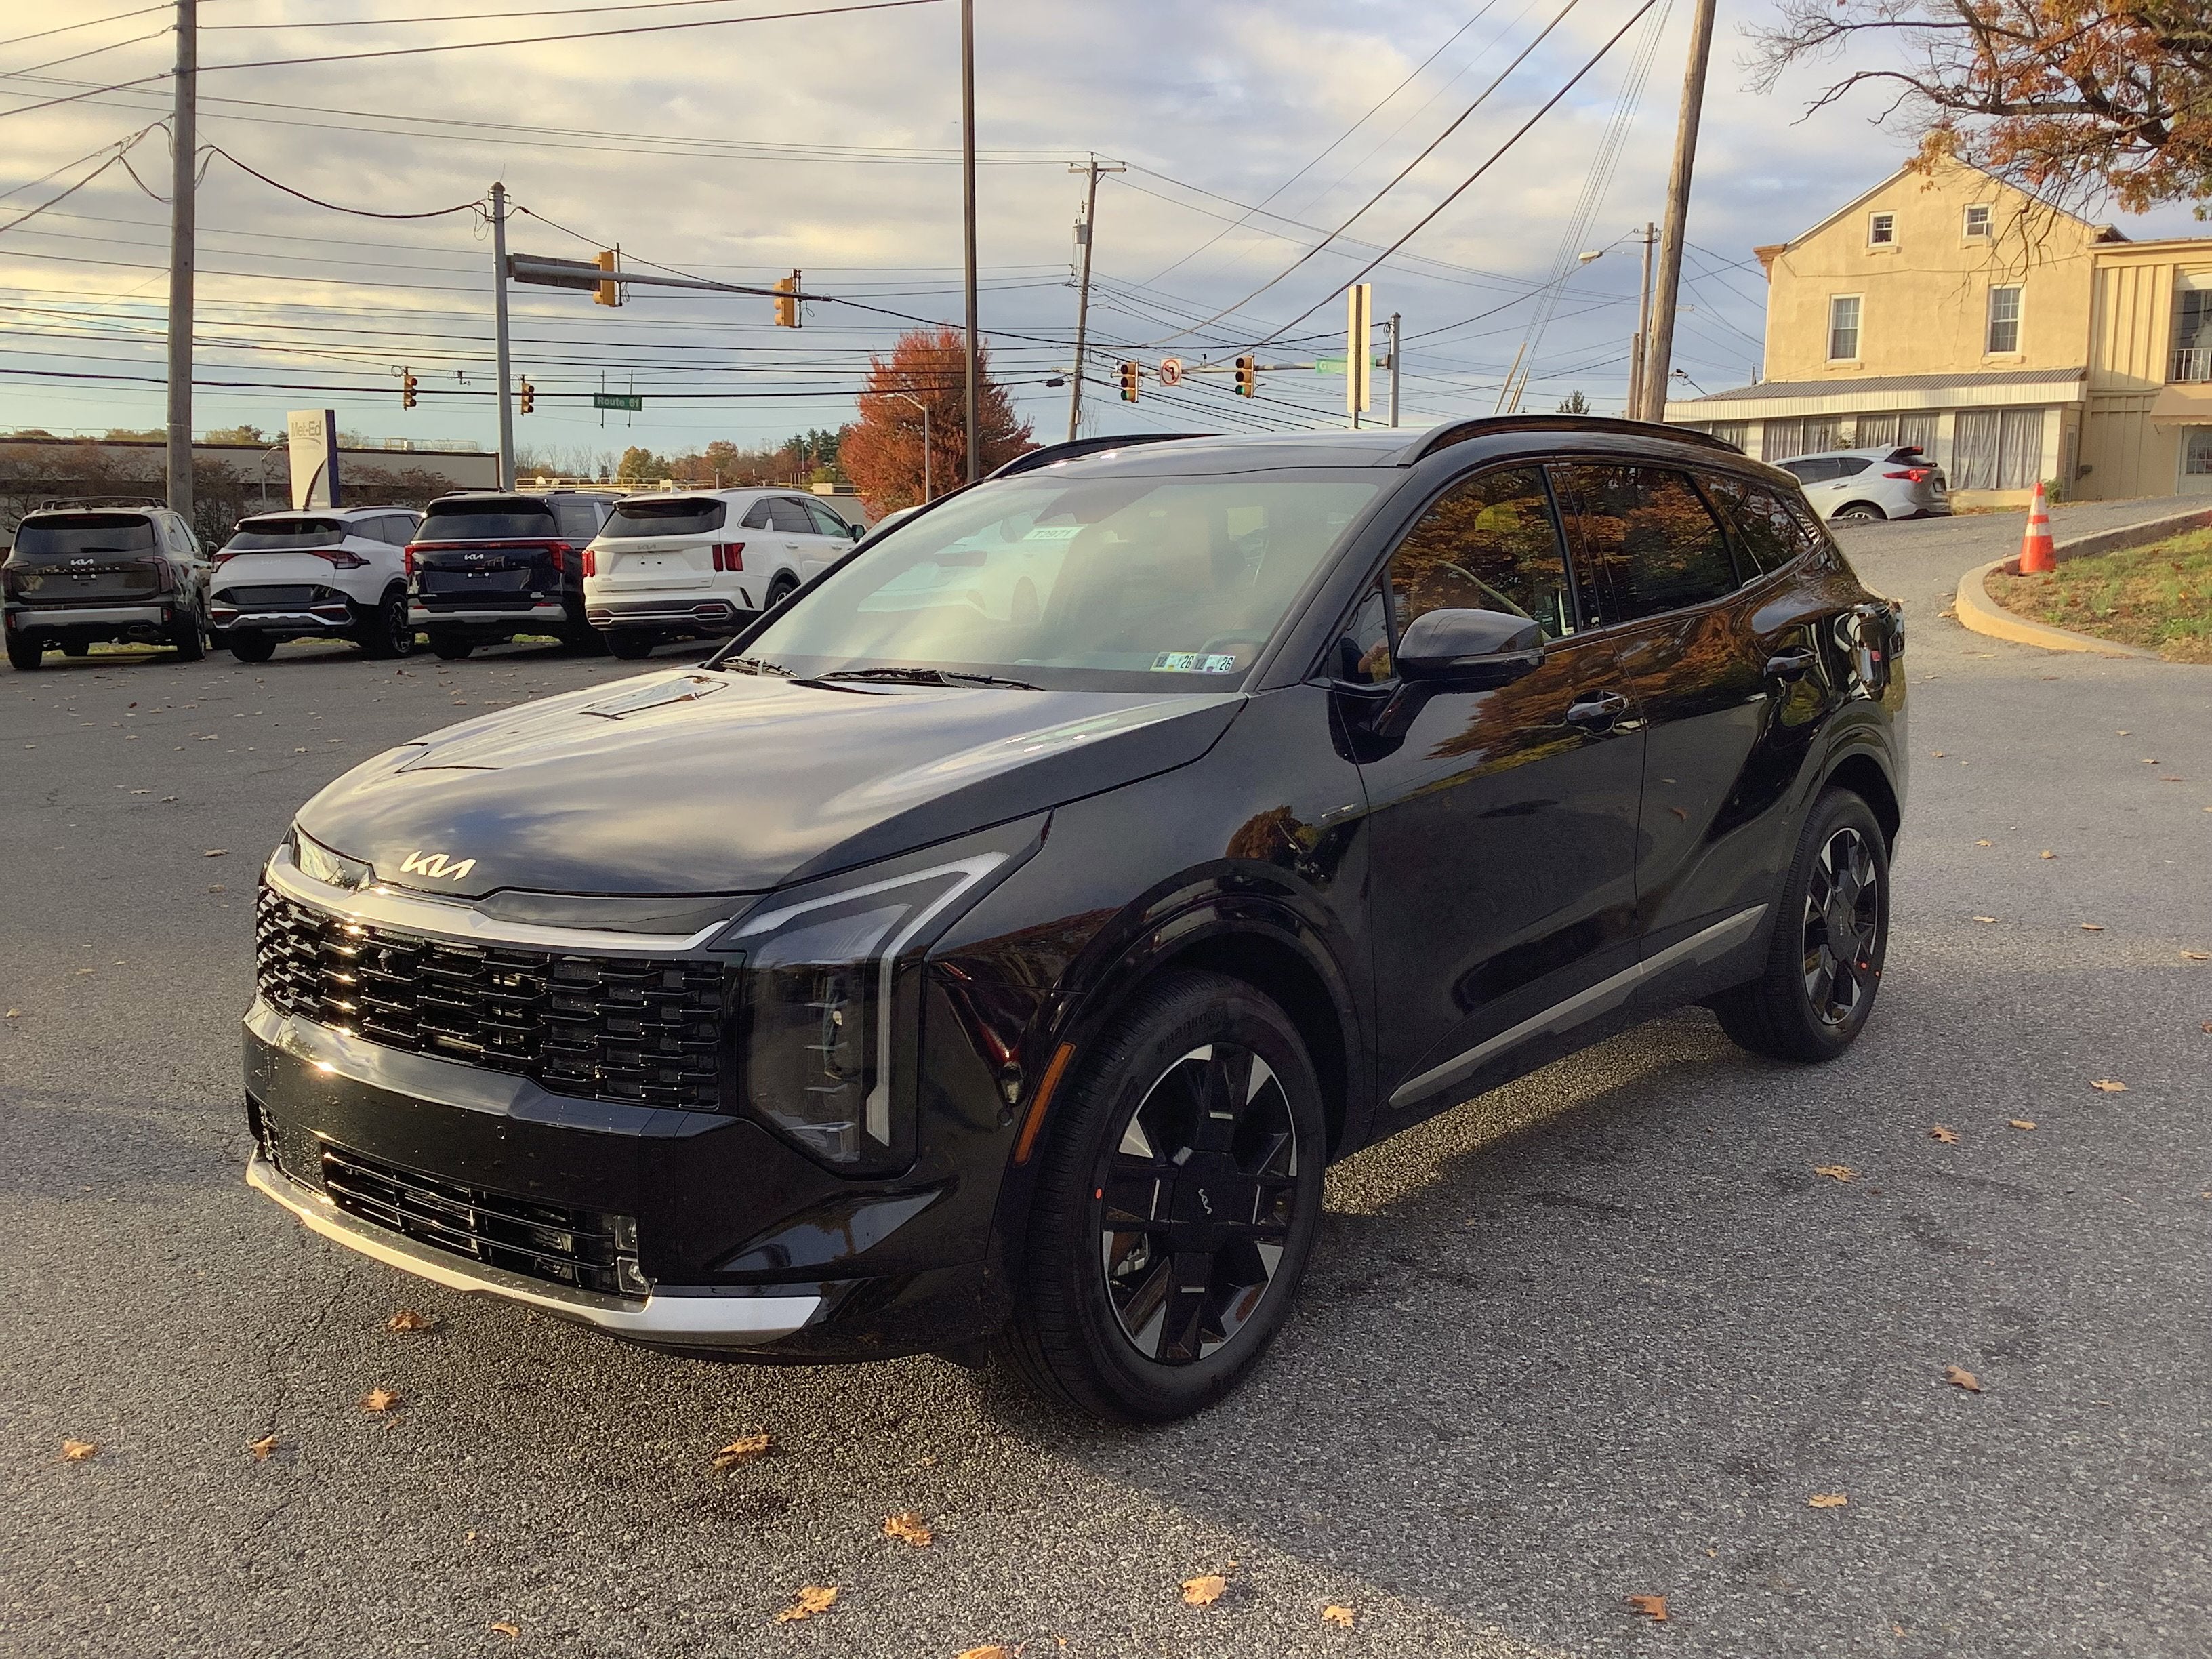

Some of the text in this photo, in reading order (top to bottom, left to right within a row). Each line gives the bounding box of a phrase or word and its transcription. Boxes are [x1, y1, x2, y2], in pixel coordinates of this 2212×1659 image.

[597, 396, 640, 407] Route 61
[291, 420, 322, 438] Met-Ed
[1180, 655, 1194, 669] 26
[1219, 657, 1233, 670] 26
[399, 850, 477, 881] KIA
